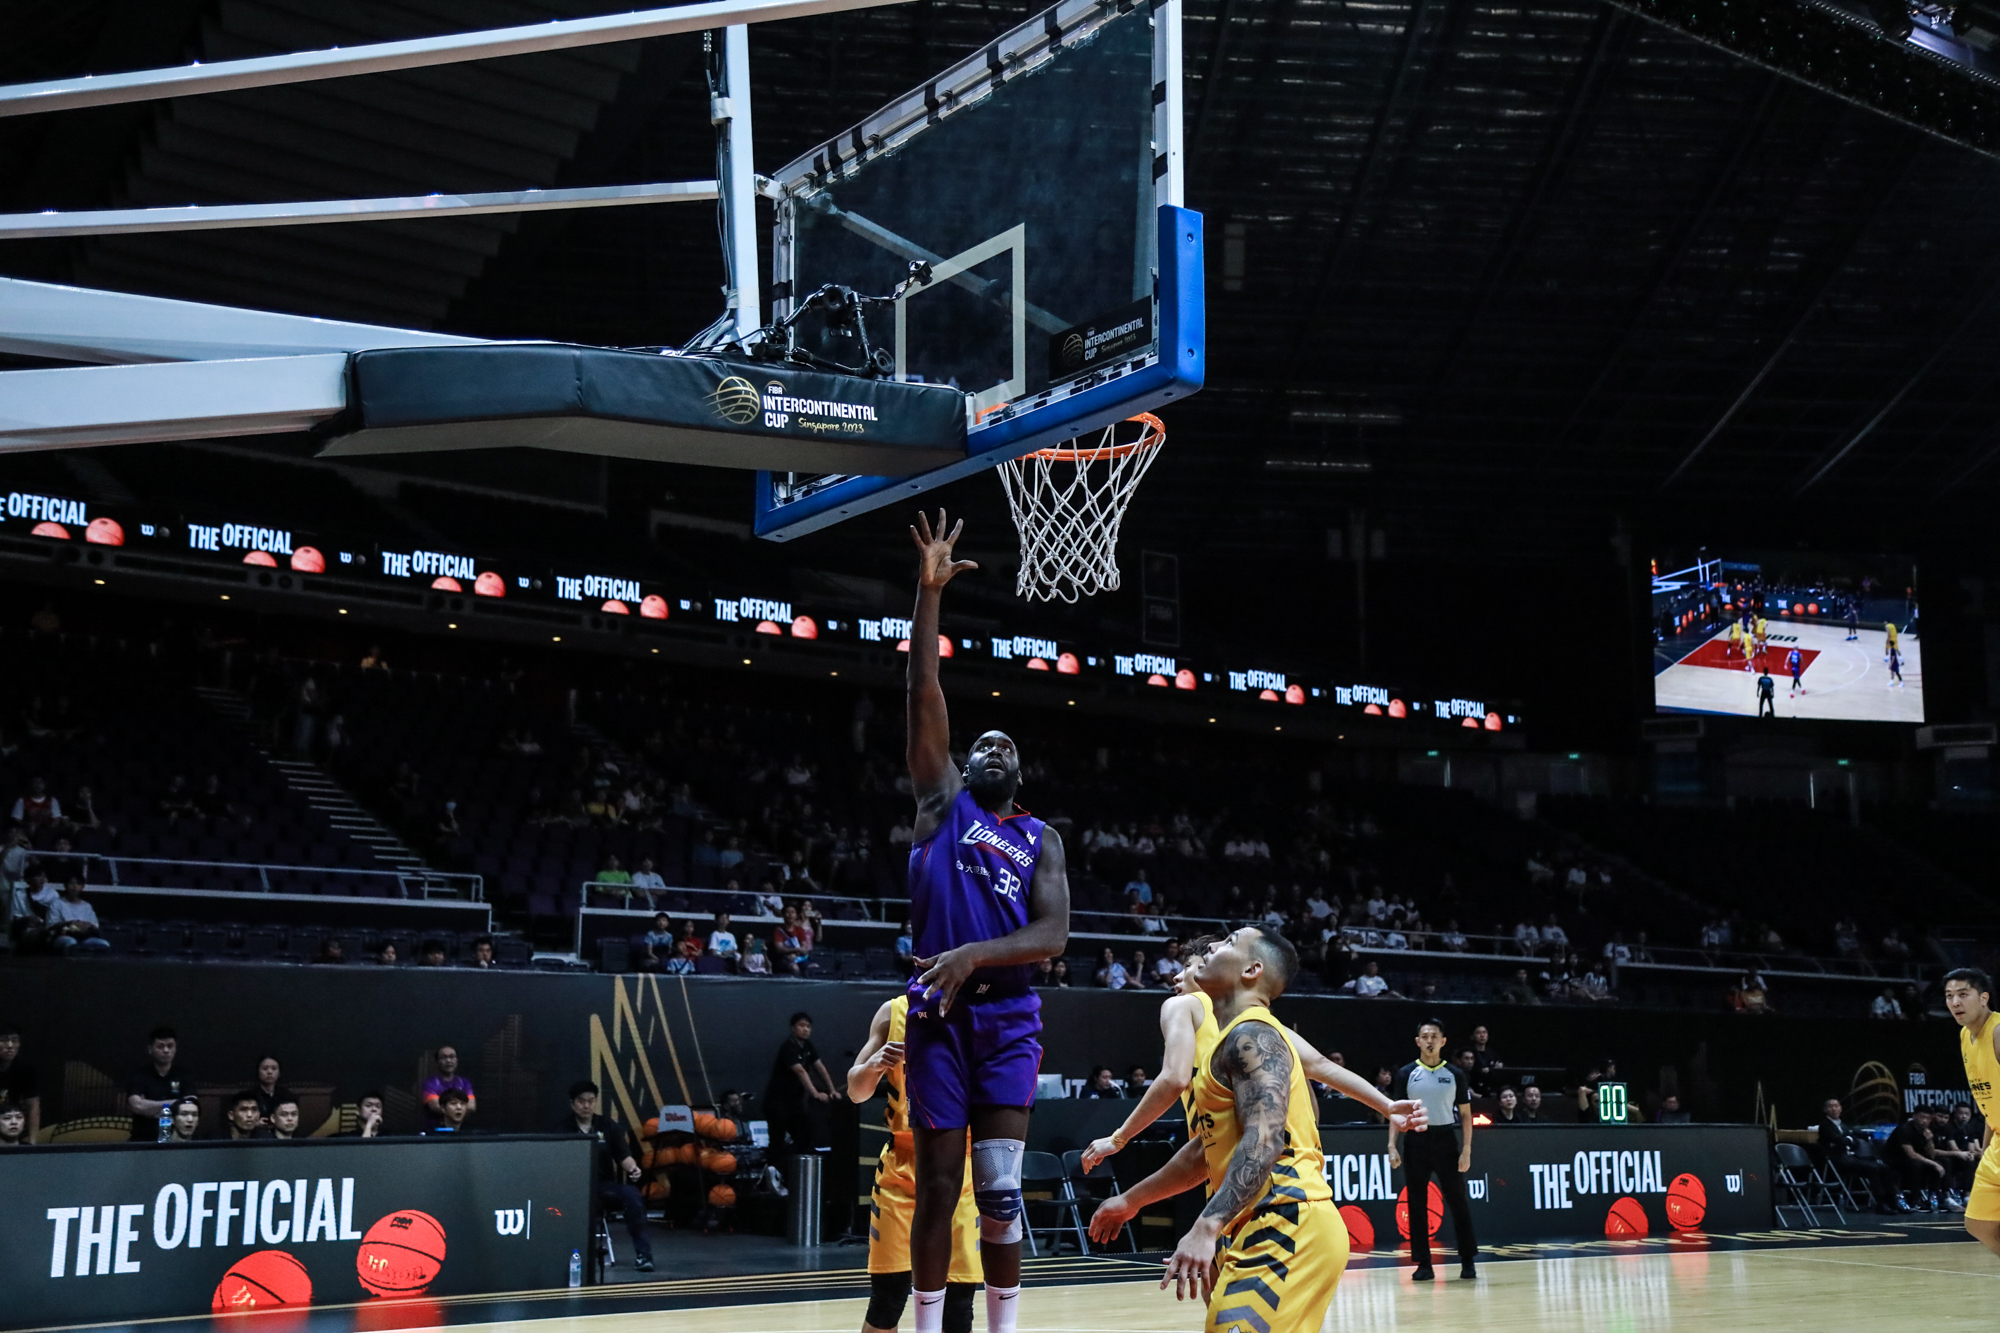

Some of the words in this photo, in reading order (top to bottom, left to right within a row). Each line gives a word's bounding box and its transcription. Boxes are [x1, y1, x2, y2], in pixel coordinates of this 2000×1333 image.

[1084, 317, 1144, 348] INTERCONTINENTAL
[1084, 348, 1097, 361] CUP
[768, 385, 783, 395] FIBA
[763, 395, 878, 421] INTERCONTINENTAL
[765, 412, 789, 429] CUP
[798, 417, 840, 434] Singapore
[842, 421, 865, 434] 2023
[8, 492, 89, 526] OFFICIAL
[188, 524, 220, 551] THE
[222, 523, 294, 555] OFFICIAL
[382, 552, 411, 577] THE
[412, 550, 477, 580] OFFICIAL
[556, 576, 582, 600] THE
[584, 575, 642, 603] OFFICIAL
[714, 599, 739, 622] THE
[740, 597, 794, 624] OFFICIAL
[858, 619, 881, 641] THE
[991, 638, 1012, 659] THE
[1013, 636, 1059, 660] OFFICIAL
[1115, 655, 1133, 675] THE
[1134, 653, 1177, 676] OFFICIAL
[1229, 671, 1246, 690] THE
[1247, 669, 1287, 692] OFFICIAL
[1335, 686, 1352, 705] THE
[1353, 684, 1390, 706] OFFICIAL
[958, 820, 1033, 868] LIONEERS
[994, 867, 1021, 902] 32
[1909, 1072, 1926, 1085] FIBA
[1600, 1086, 1625, 1120] 00
[1529, 1164, 1572, 1209] THE
[1574, 1151, 1667, 1194] OFFICIAL
[47, 1204, 144, 1277] THE
[153, 1179, 362, 1249] OFFICIAL
